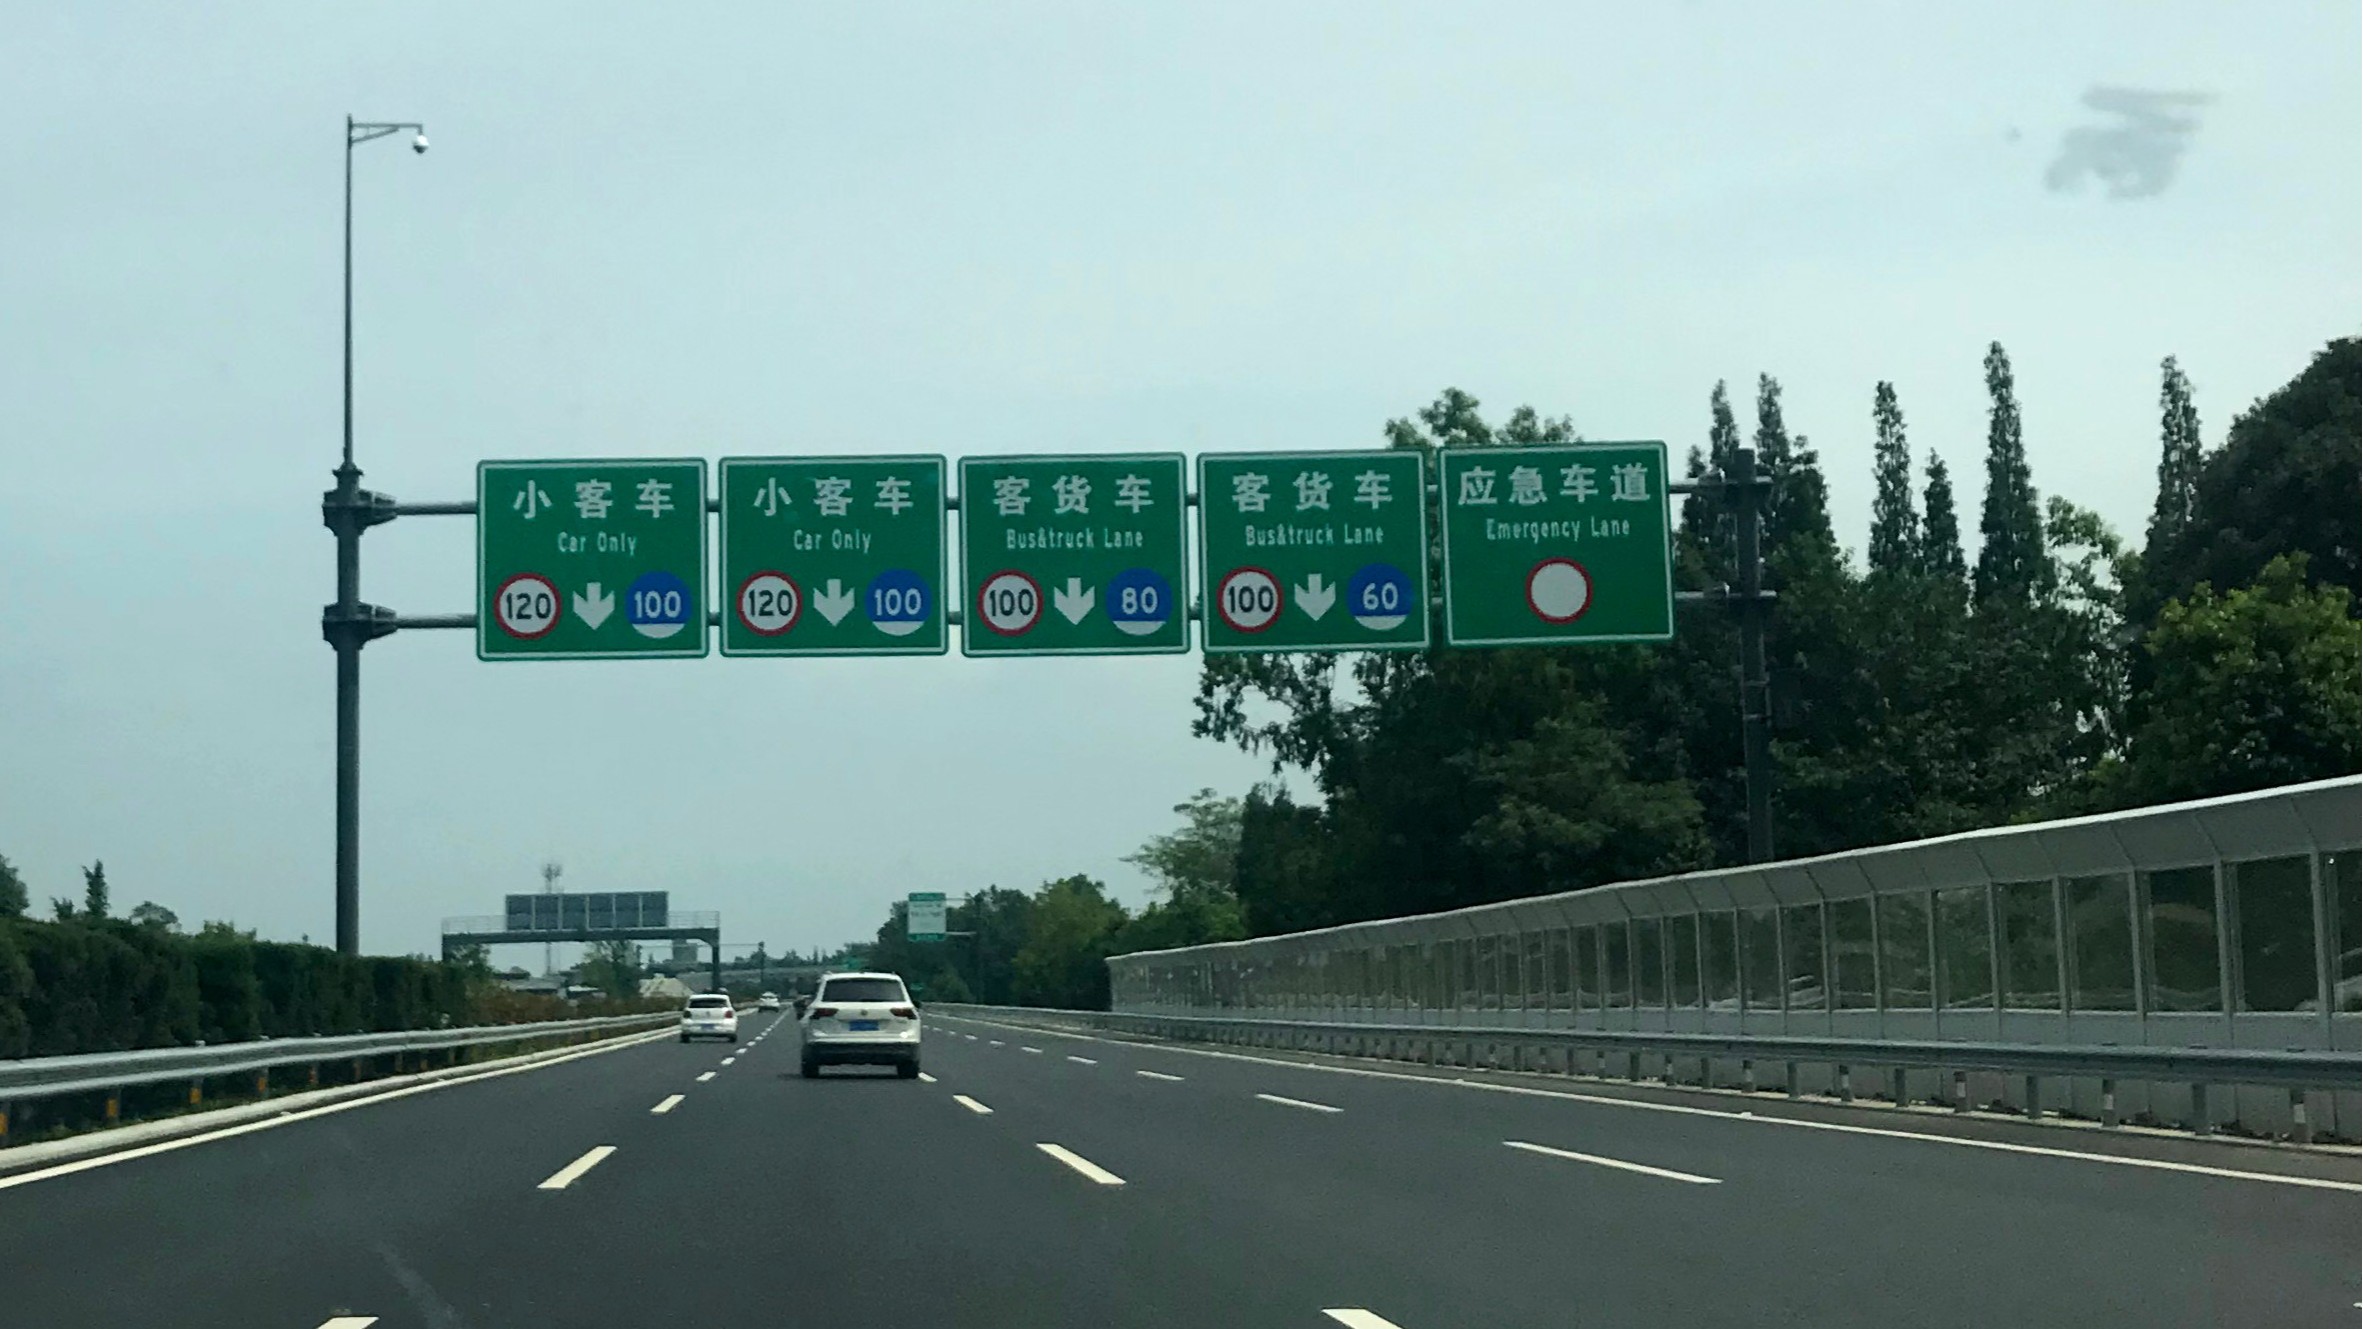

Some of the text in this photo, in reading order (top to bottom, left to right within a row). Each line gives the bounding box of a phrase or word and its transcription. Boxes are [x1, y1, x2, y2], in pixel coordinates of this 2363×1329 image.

[754, 477, 912, 516] 小客车
[993, 475, 1154, 514] 客货车
[1232, 470, 1392, 512] 客货车
[1458, 463, 1650, 505] 应急车道
[513, 479, 674, 518] 小客车
[558, 532, 635, 555] Car Only
[794, 529, 871, 553] Car Only
[1006, 527, 1143, 548] Bus&truck Lane
[1246, 523, 1383, 545] Bus&truck Lane
[1486, 517, 1629, 543] Emergency Lane
[505, 593, 551, 619] 120
[634, 591, 680, 618] 100
[749, 590, 794, 617] 120
[874, 588, 920, 616] 100
[990, 589, 1035, 616] 100
[1122, 587, 1158, 614] 80
[1229, 586, 1274, 613] 100
[1362, 583, 1397, 610] 60
